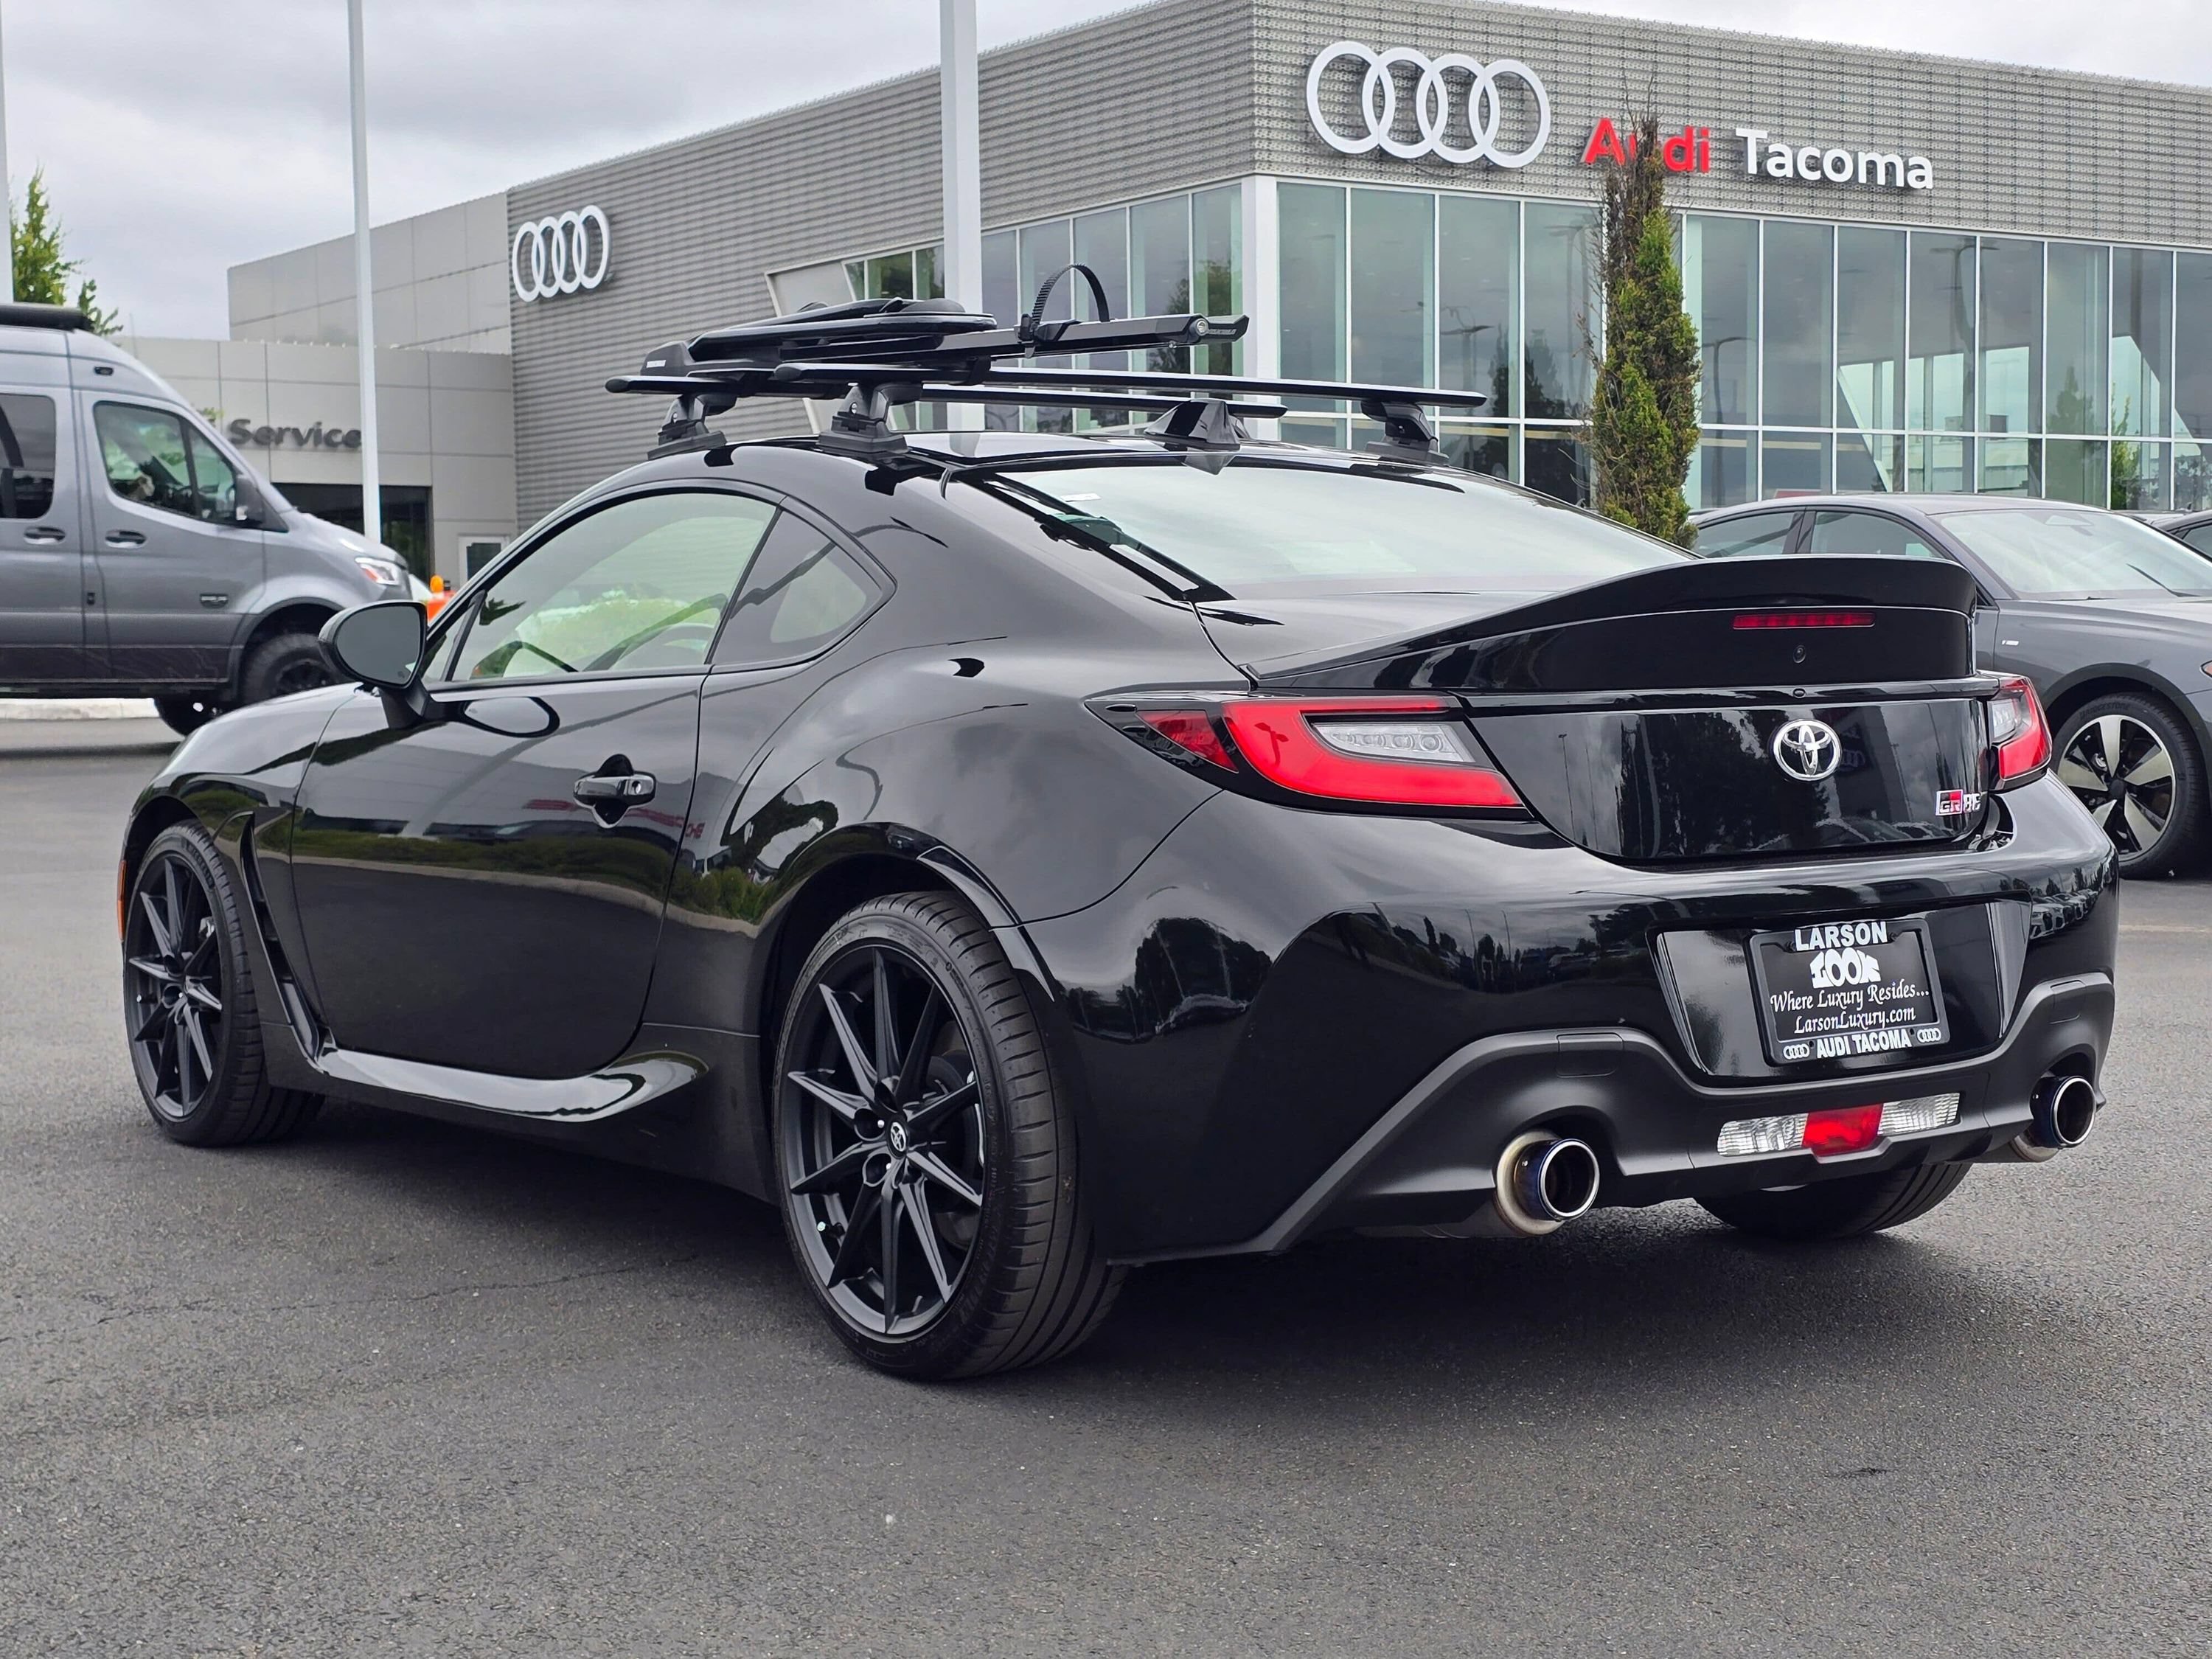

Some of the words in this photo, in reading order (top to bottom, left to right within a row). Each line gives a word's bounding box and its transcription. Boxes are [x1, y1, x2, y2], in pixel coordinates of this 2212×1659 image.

[1736, 128, 1933, 189] Tacoma
[229, 419, 362, 448] Service
[1794, 921, 1888, 952] LARSON
[1770, 990, 1813, 1013] Where
[1817, 989, 1864, 1011] Luxury
[1868, 978, 1930, 1004] Resides...
[1794, 1007, 1916, 1034] LarsonLuxury.com
[1817, 1038, 1851, 1059] AUDI
[1852, 1029, 1913, 1054] TACOMA
